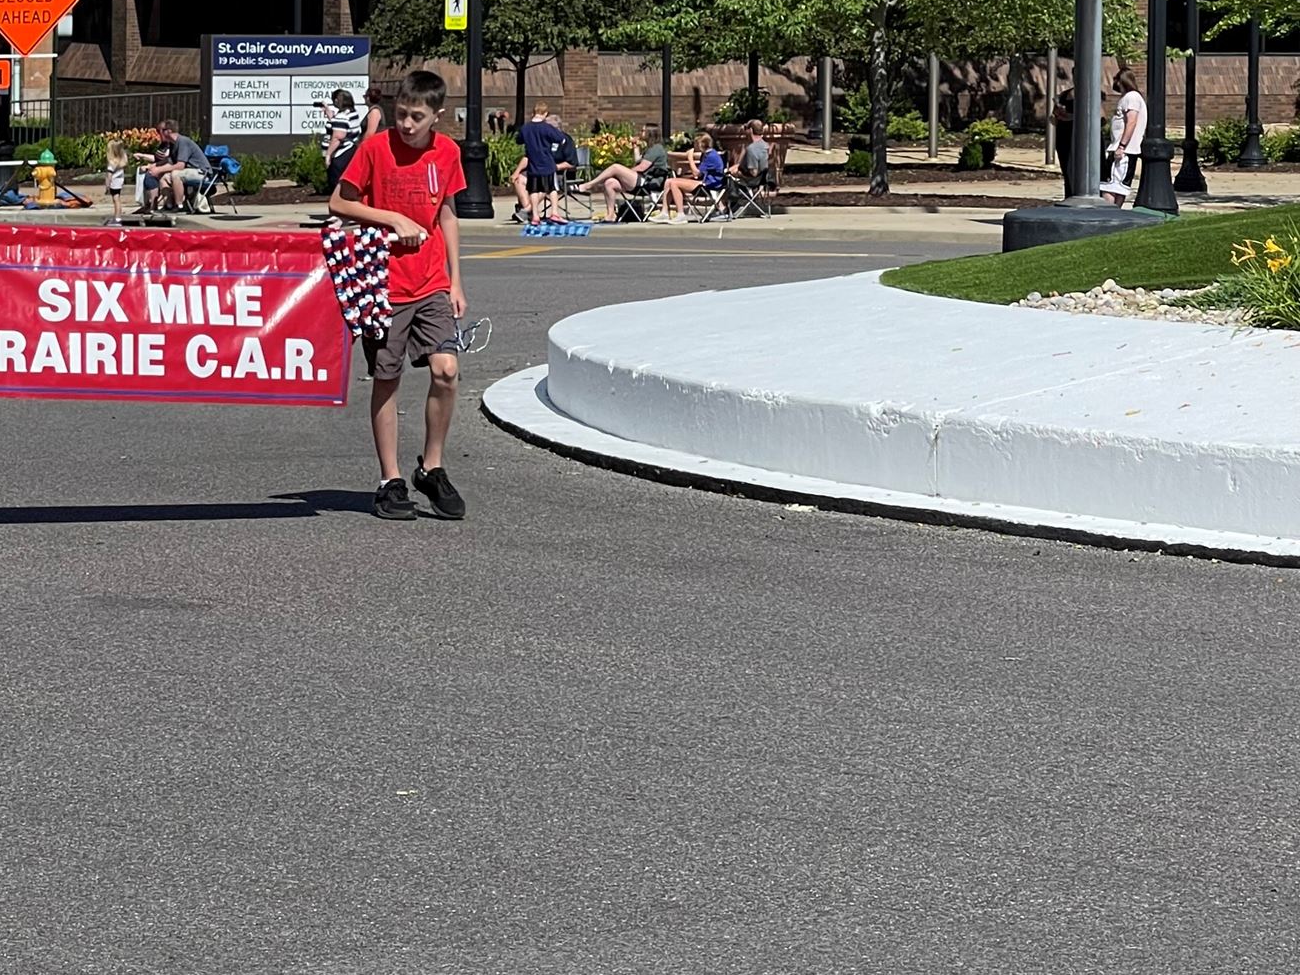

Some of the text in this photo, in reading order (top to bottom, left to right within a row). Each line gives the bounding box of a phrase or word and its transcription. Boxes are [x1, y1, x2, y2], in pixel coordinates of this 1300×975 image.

[1, 10, 51, 24] AHEAD
[218, 42, 354, 56] St. Clair County Annex
[219, 57, 288, 66] 19 Public Square
[234, 81, 269, 89] HEALTH
[294, 81, 365, 89] INTERGOVERNMENTAL
[221, 91, 281, 99] DEPARTMENT
[311, 91, 332, 99] GRA
[221, 111, 281, 119] ARBITRATION
[229, 121, 273, 129] SERVICES
[38, 278, 264, 326] SIX MILE
[185, 336, 328, 382] C.A.R.
